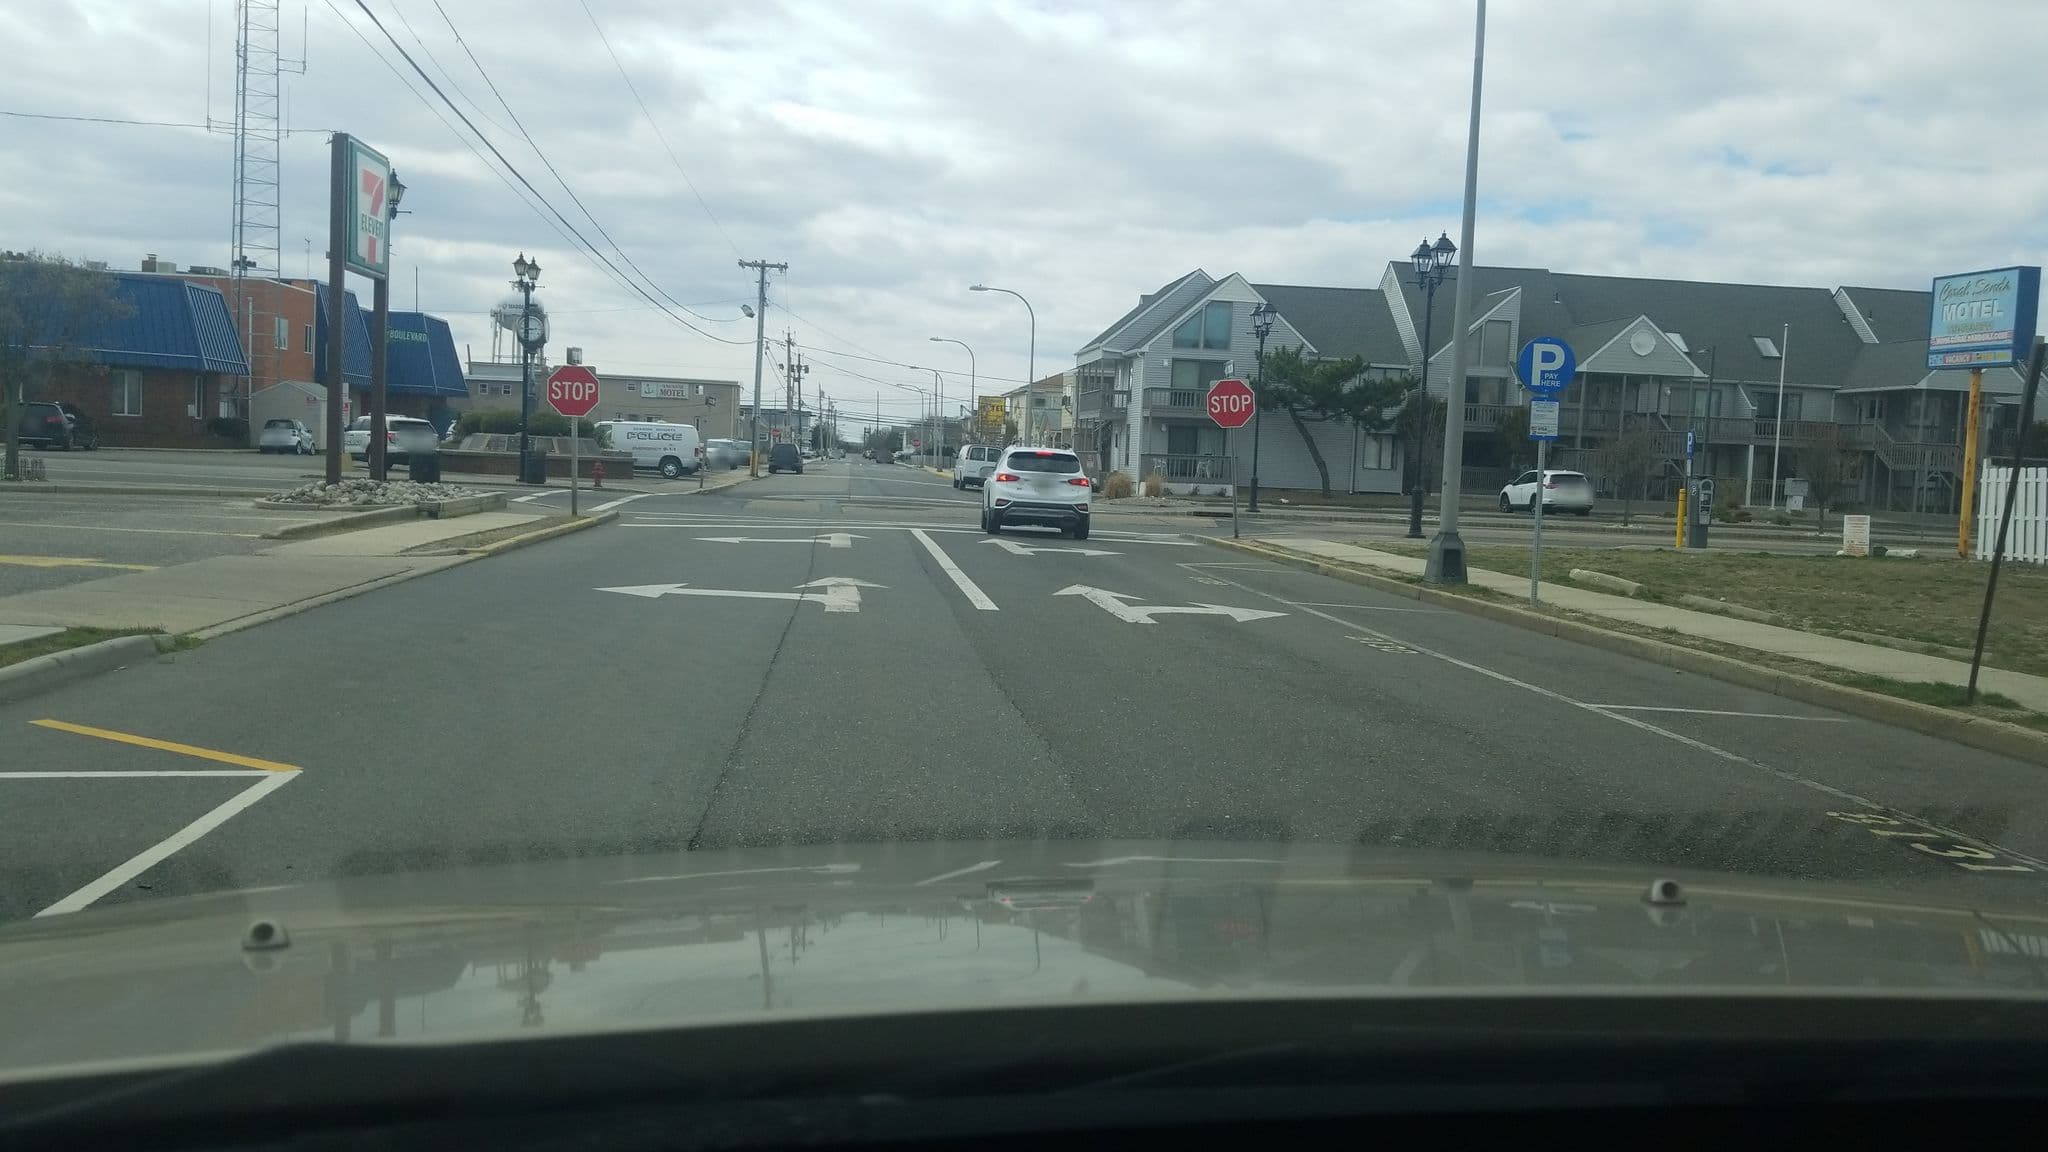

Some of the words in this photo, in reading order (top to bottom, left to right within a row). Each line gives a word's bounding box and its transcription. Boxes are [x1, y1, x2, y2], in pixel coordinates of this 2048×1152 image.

[1941, 299, 2004, 321] MOTEL
[390, 329, 427, 342] BOULEVARD
[1531, 343, 1565, 386] P
[551, 381, 596, 401] STOP
[1211, 394, 1251, 413] STOP
[627, 432, 682, 440] POLICE
[1826, 811, 2036, 872] 8131
